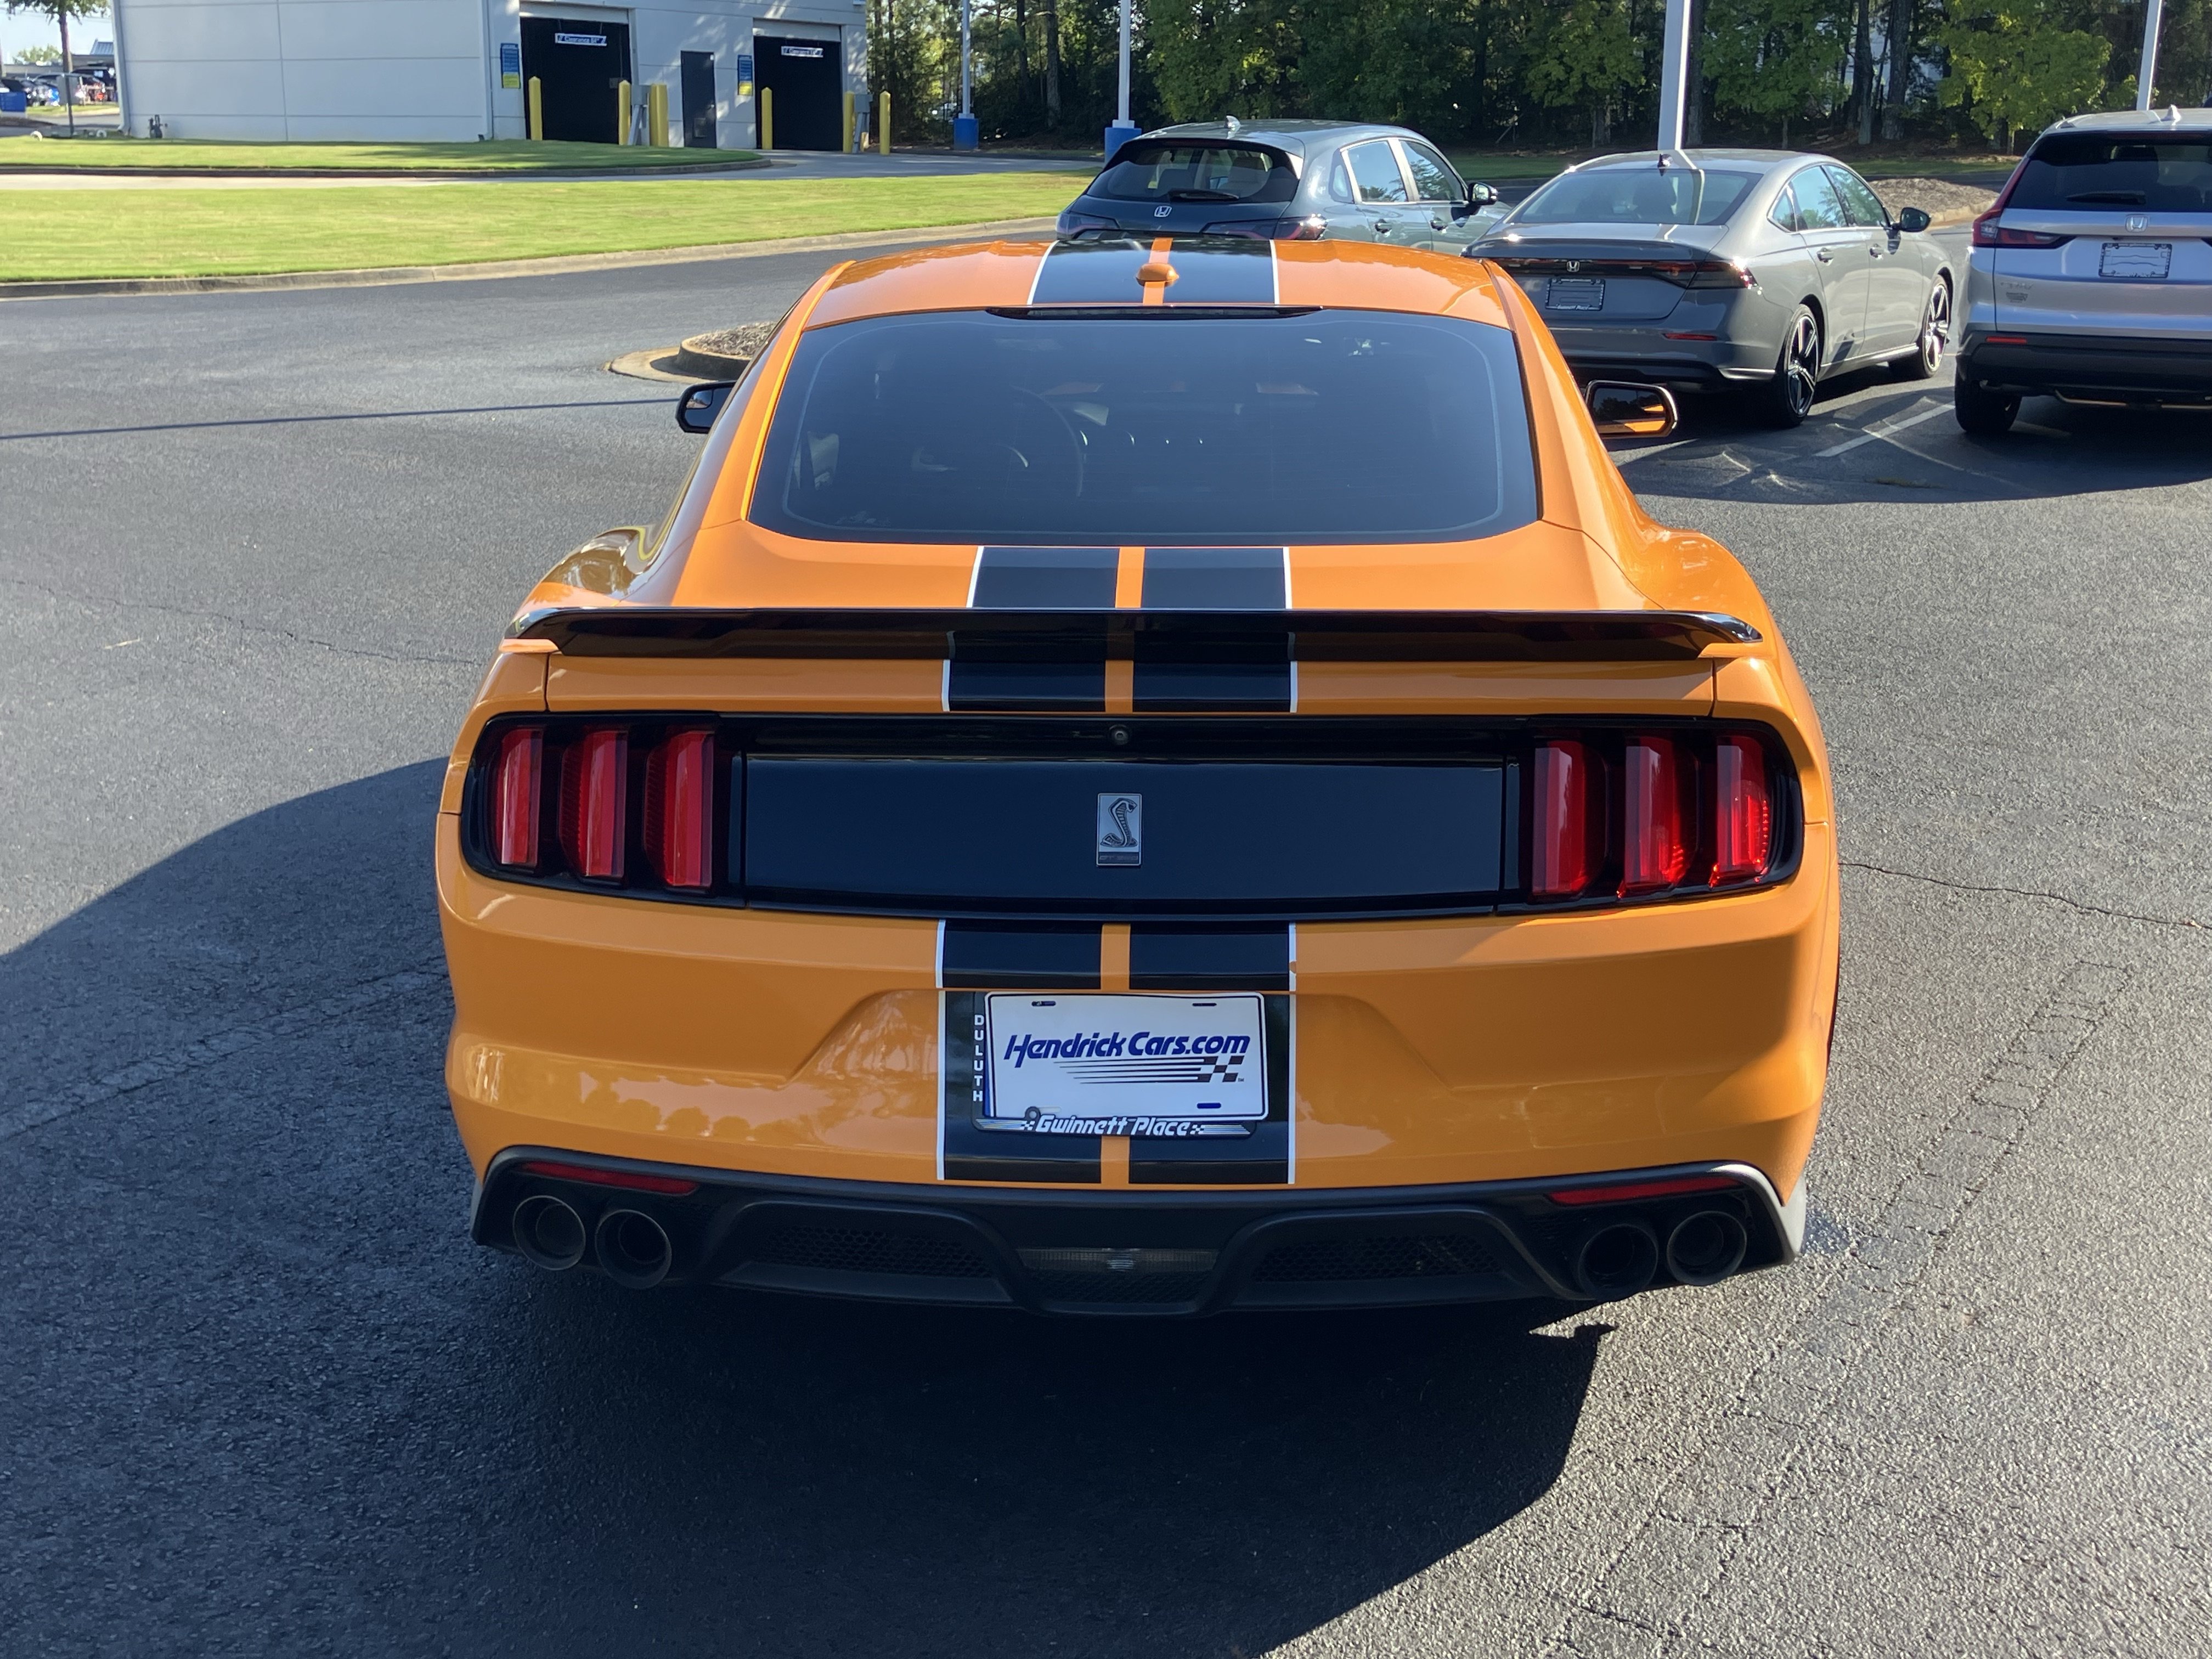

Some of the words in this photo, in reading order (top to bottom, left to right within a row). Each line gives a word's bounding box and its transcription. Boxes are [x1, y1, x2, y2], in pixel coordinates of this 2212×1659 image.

[973, 1014, 985, 1102] DULUTH
[1035, 1114, 1128, 1135] Gwinnett
[1130, 1116, 1191, 1136] Place
